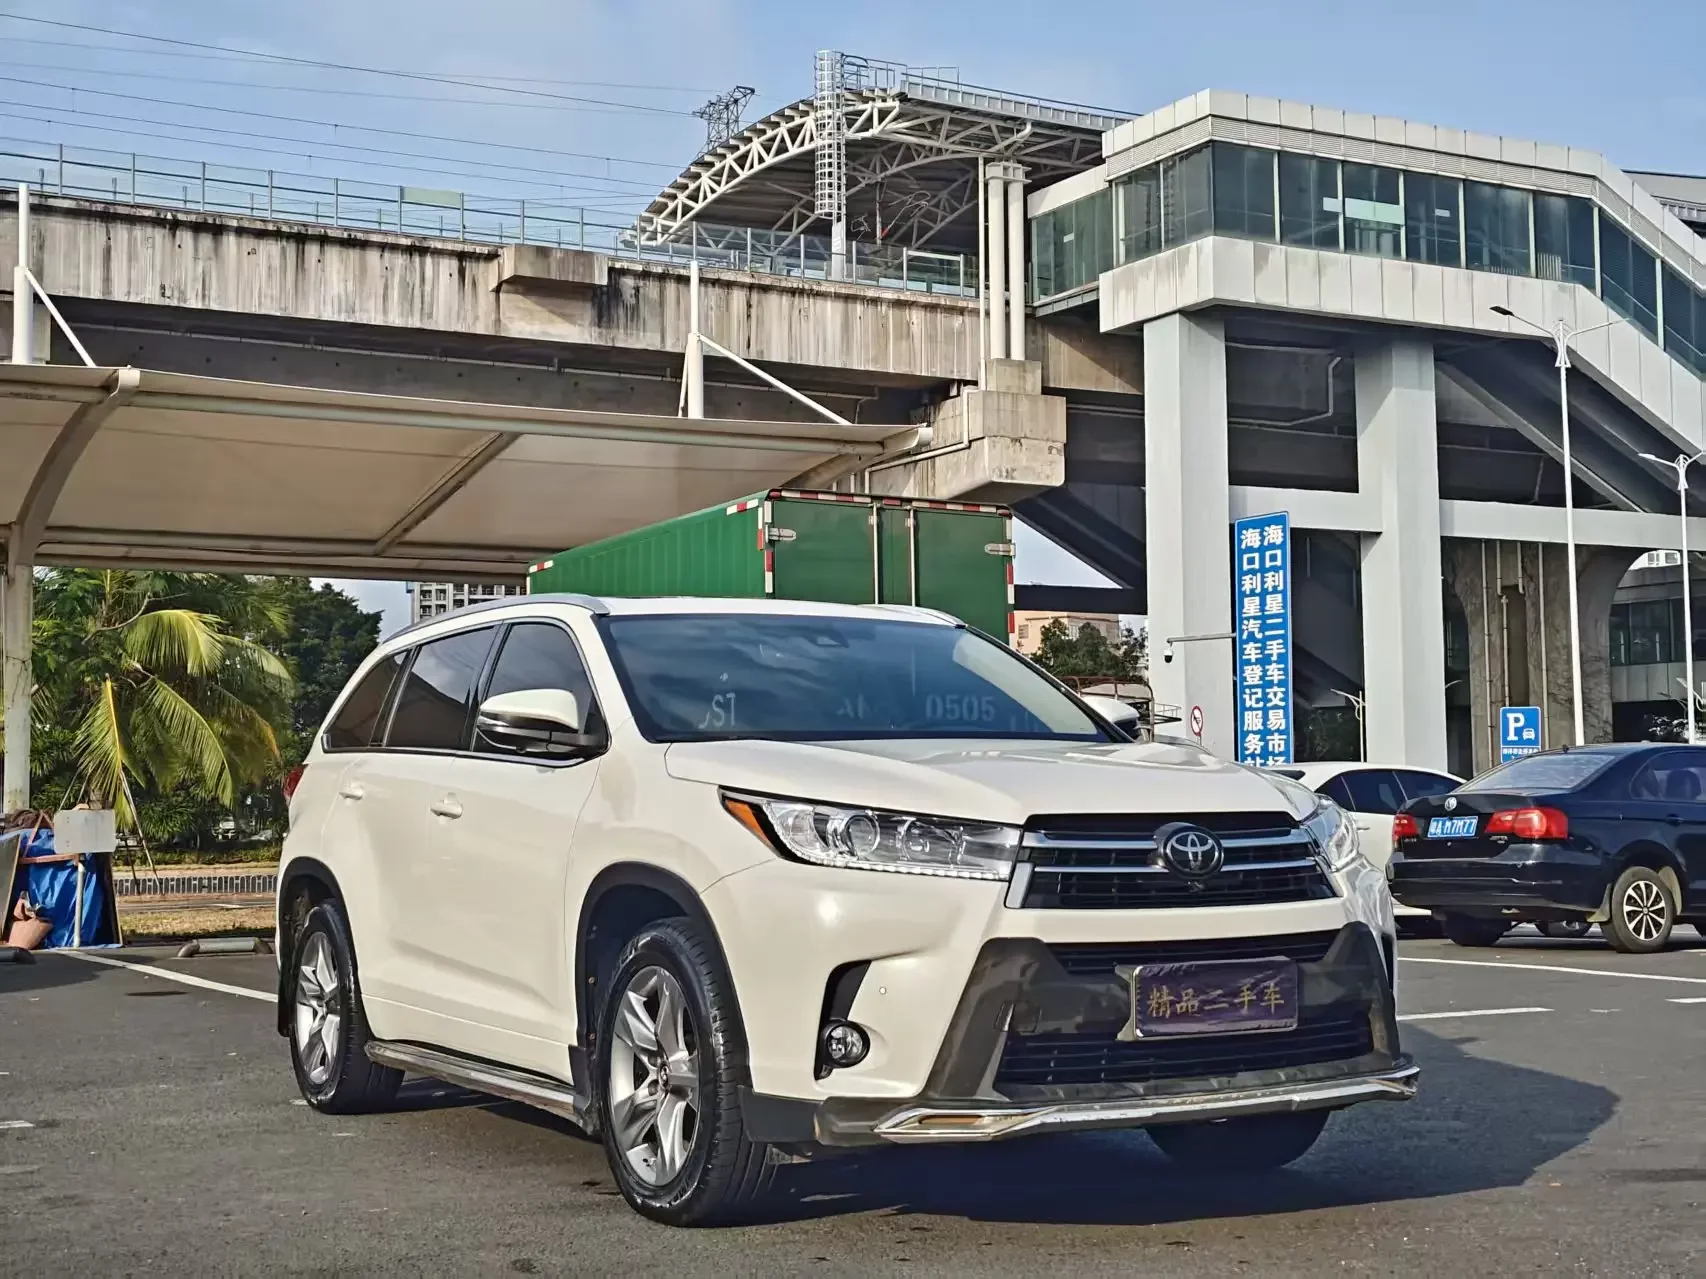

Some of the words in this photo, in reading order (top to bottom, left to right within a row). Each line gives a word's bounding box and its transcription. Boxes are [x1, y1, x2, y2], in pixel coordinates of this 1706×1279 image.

[1506, 712, 1525, 741] P
[1147, 982, 1285, 1019] 精品二手车
